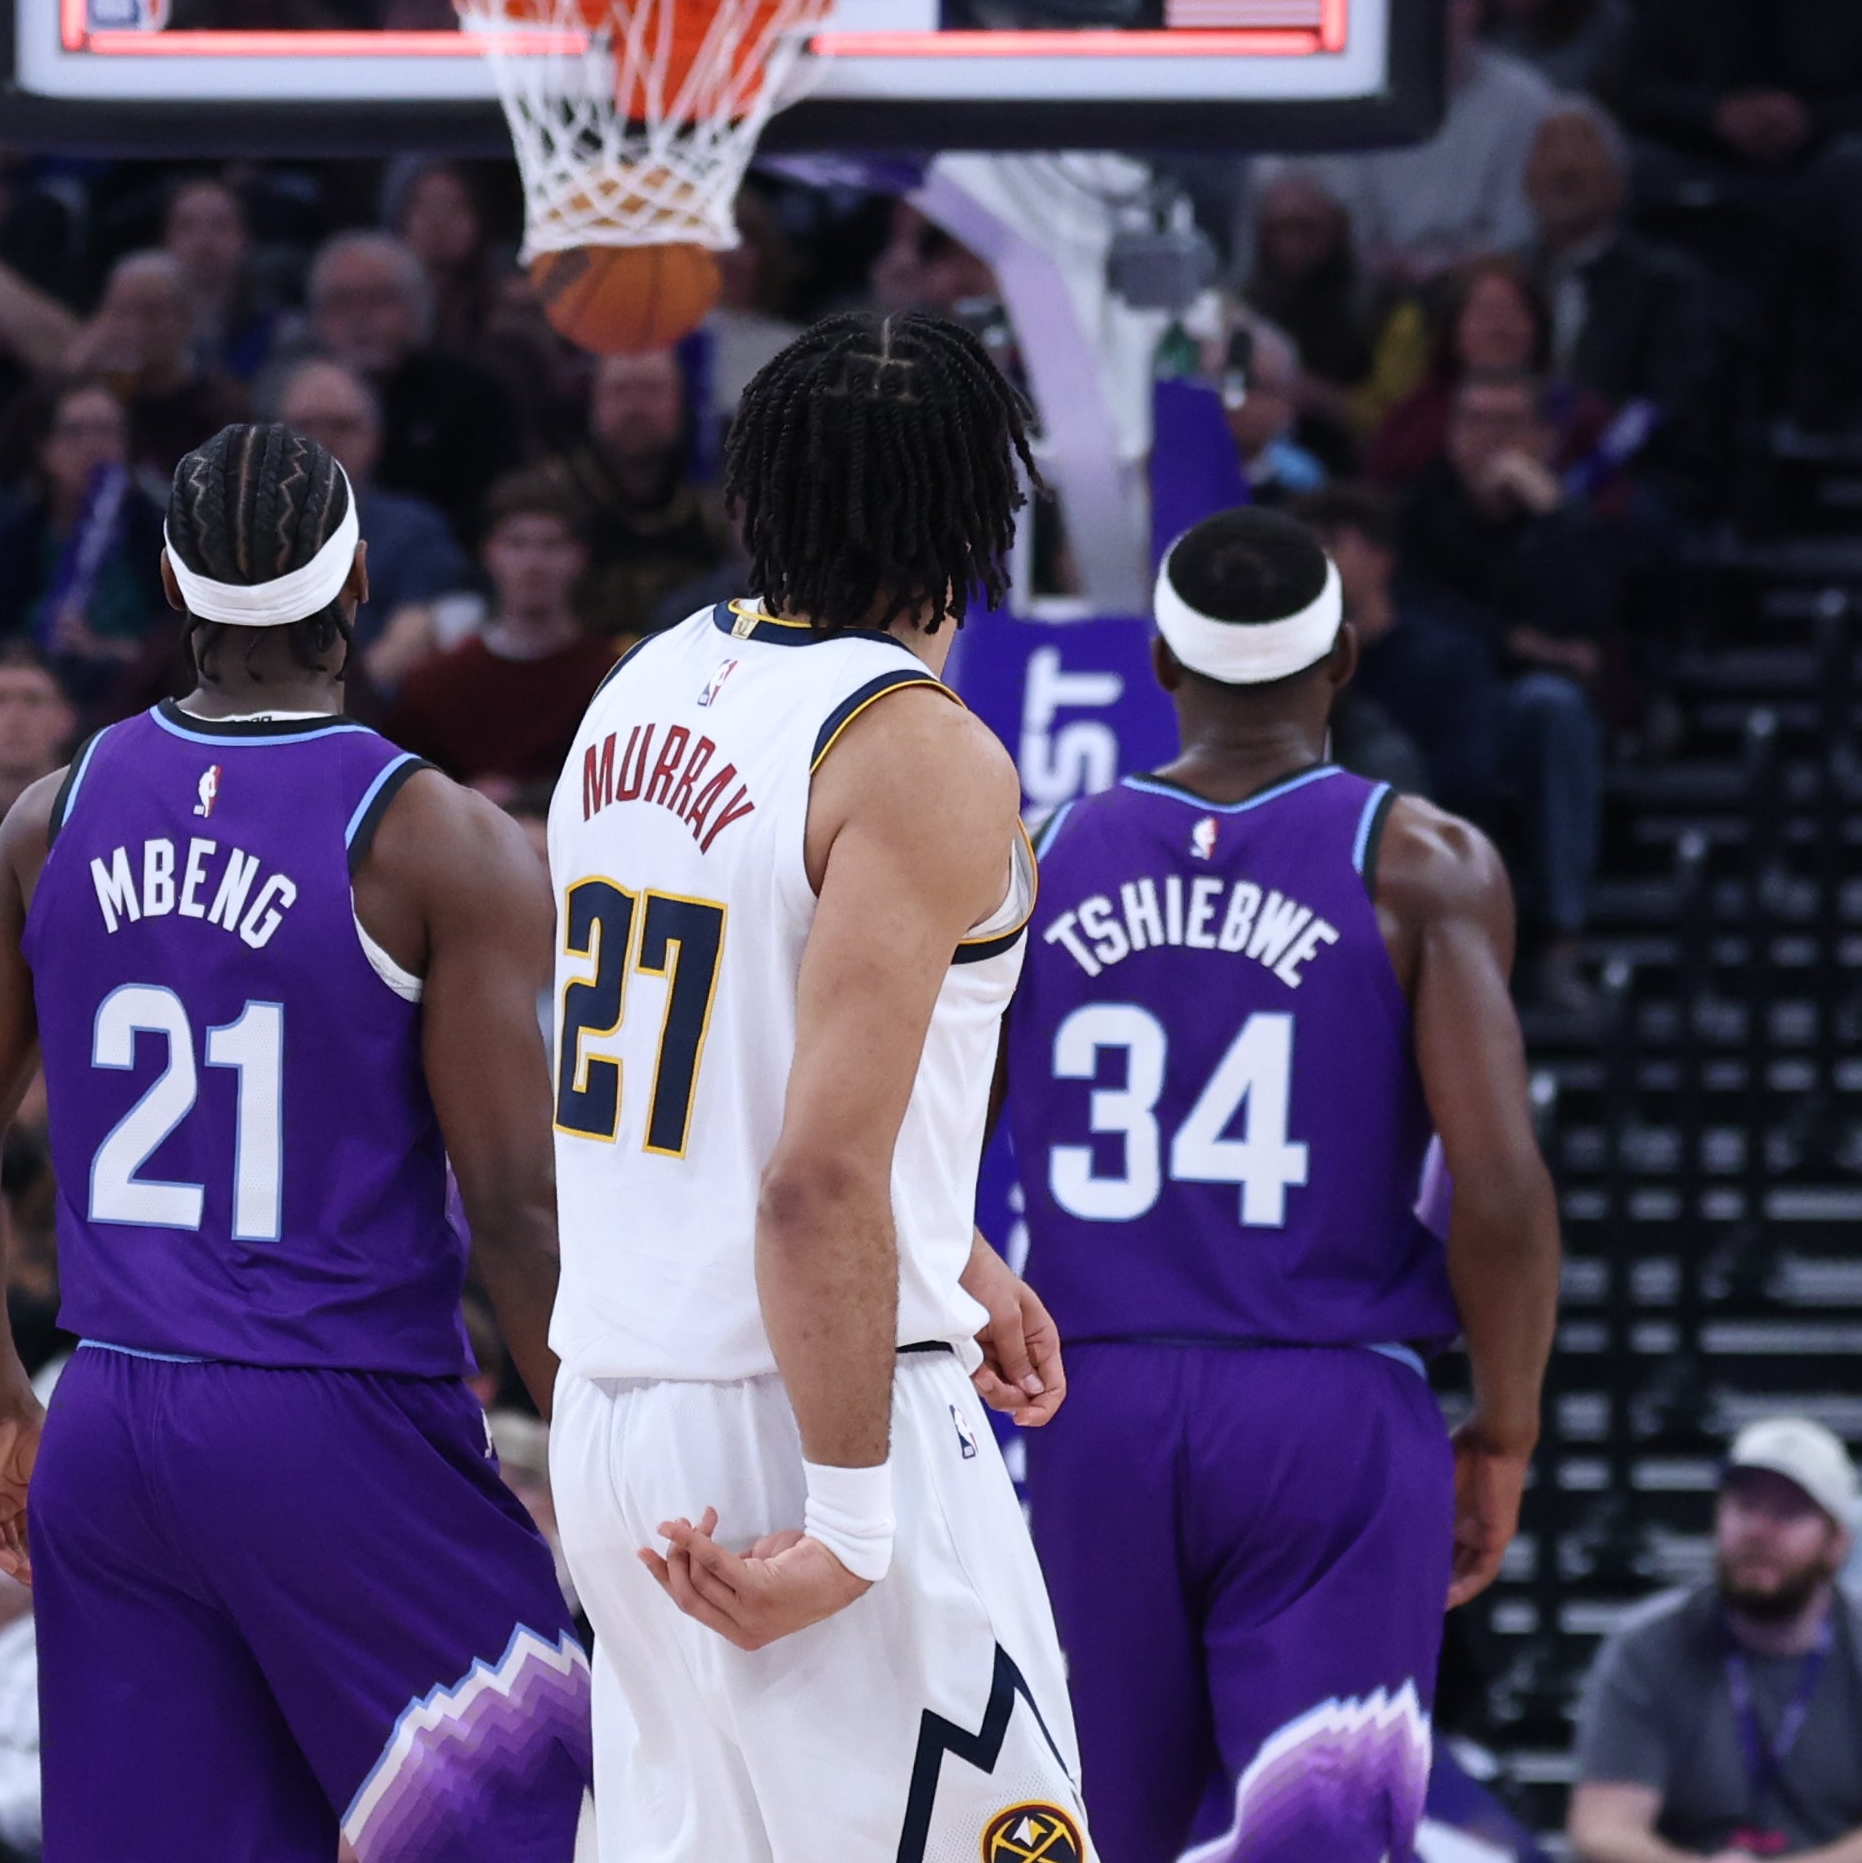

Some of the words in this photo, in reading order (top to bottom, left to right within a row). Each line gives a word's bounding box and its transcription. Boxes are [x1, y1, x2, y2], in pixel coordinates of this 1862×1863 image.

[583, 723, 754, 854] MURRAY
[1020, 646, 1123, 812] ST
[90, 837, 297, 949] MBENG
[1043, 876, 1340, 989] TSHIEBWE
[553, 874, 727, 1160] 27
[87, 982, 284, 1243] 21
[1048, 1001, 1309, 1228] 34
